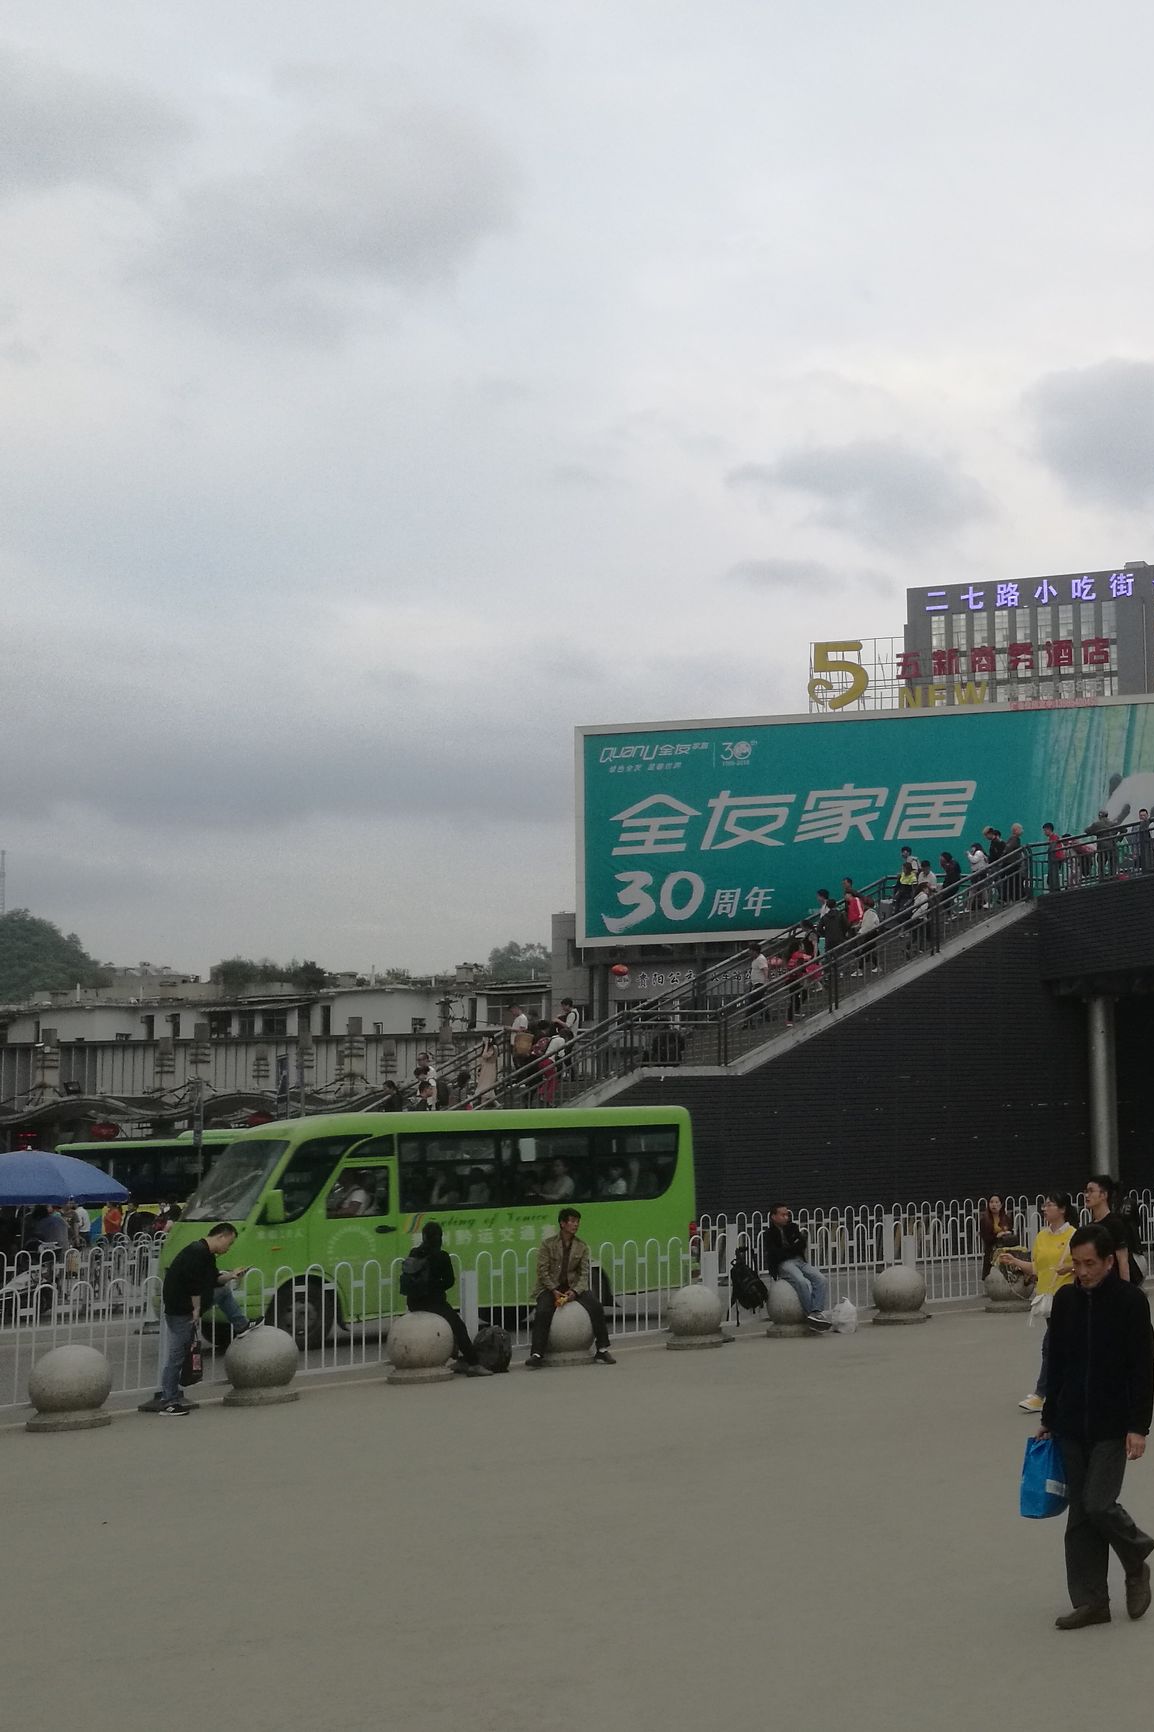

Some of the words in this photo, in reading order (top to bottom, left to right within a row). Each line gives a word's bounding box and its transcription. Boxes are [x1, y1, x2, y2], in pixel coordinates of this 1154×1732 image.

[925, 573, 1135, 611] 二七路小吃街
[896, 637, 1110, 680] 五新商务酒店
[609, 780, 977, 856] 全友家居
